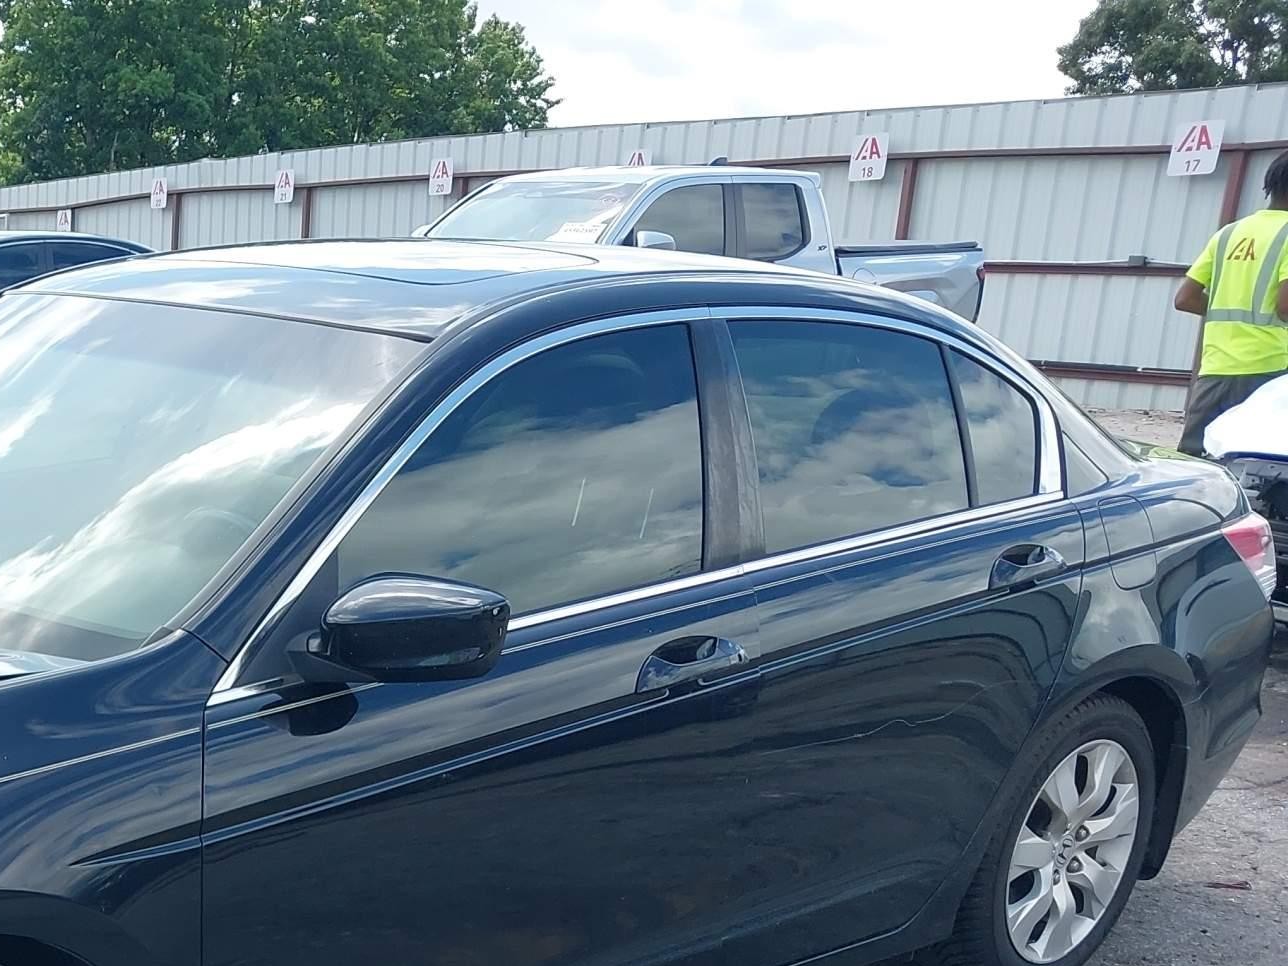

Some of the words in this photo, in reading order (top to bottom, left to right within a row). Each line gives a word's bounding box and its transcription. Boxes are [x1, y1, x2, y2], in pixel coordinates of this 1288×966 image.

[1184, 159, 1201, 172] 17
[862, 166, 874, 178] 18
[435, 183, 445, 193] 20
